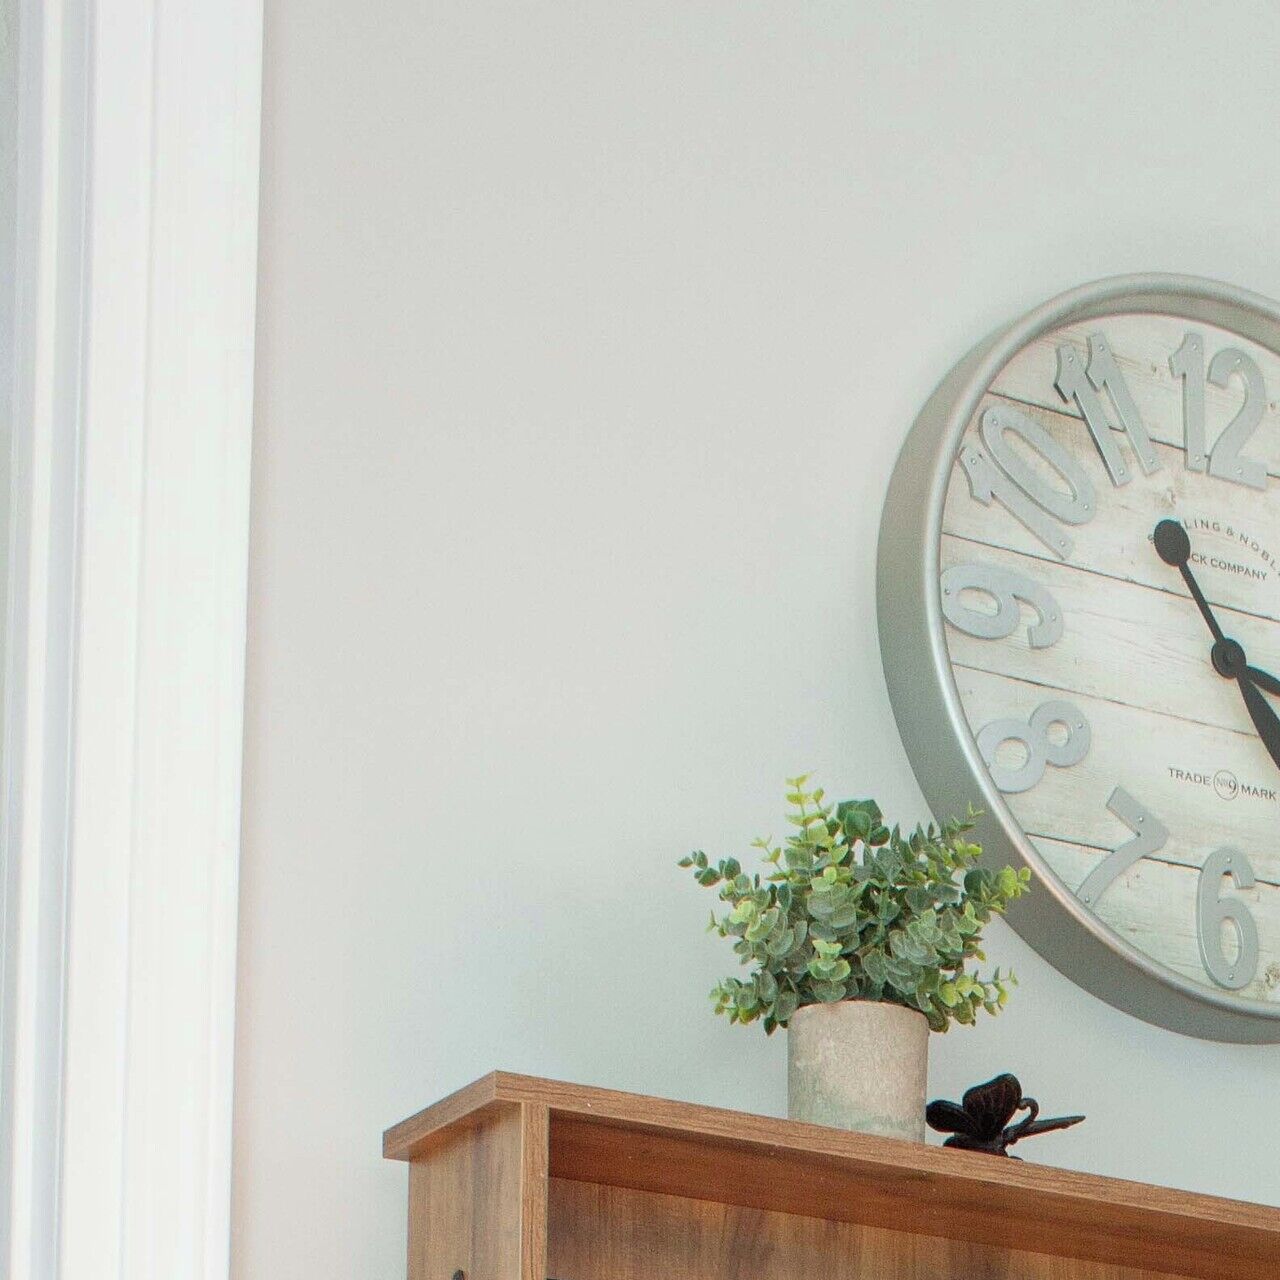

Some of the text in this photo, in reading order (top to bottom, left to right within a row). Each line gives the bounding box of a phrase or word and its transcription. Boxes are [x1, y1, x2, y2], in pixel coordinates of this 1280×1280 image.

[1053, 332, 1160, 488] 11
[1168, 332, 1268, 491] 12
[959, 405, 1097, 561] 10
[942, 563, 1066, 649] 9
[1210, 557, 1268, 581] COMPANY
[975, 699, 1091, 794] 8
[1168, 767, 1212, 786] TRADE
[1241, 784, 1277, 801] MARK
[1076, 785, 1170, 908] 7
[1195, 845, 1260, 991] 6
